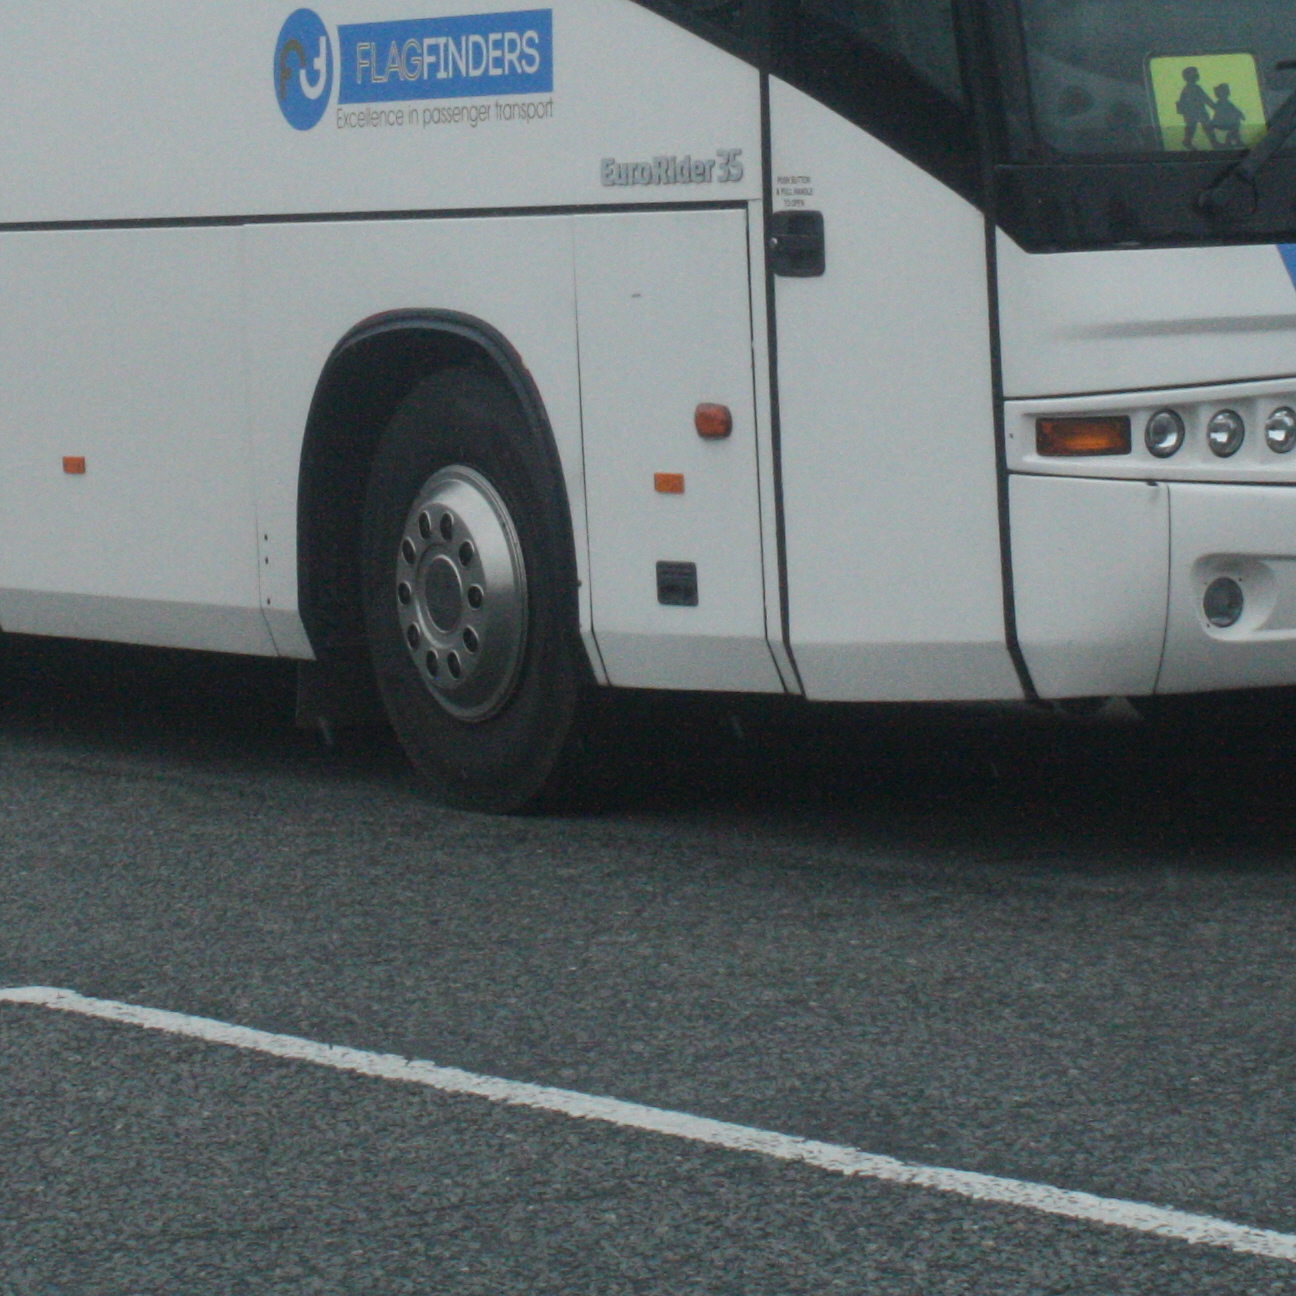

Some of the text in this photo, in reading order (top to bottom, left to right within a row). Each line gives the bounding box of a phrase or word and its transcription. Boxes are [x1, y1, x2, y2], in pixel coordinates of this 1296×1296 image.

[356, 30, 540, 84] FLAGFINDERS
[336, 97, 553, 129] Excellence in passenger transport
[716, 148, 744, 183] 35
